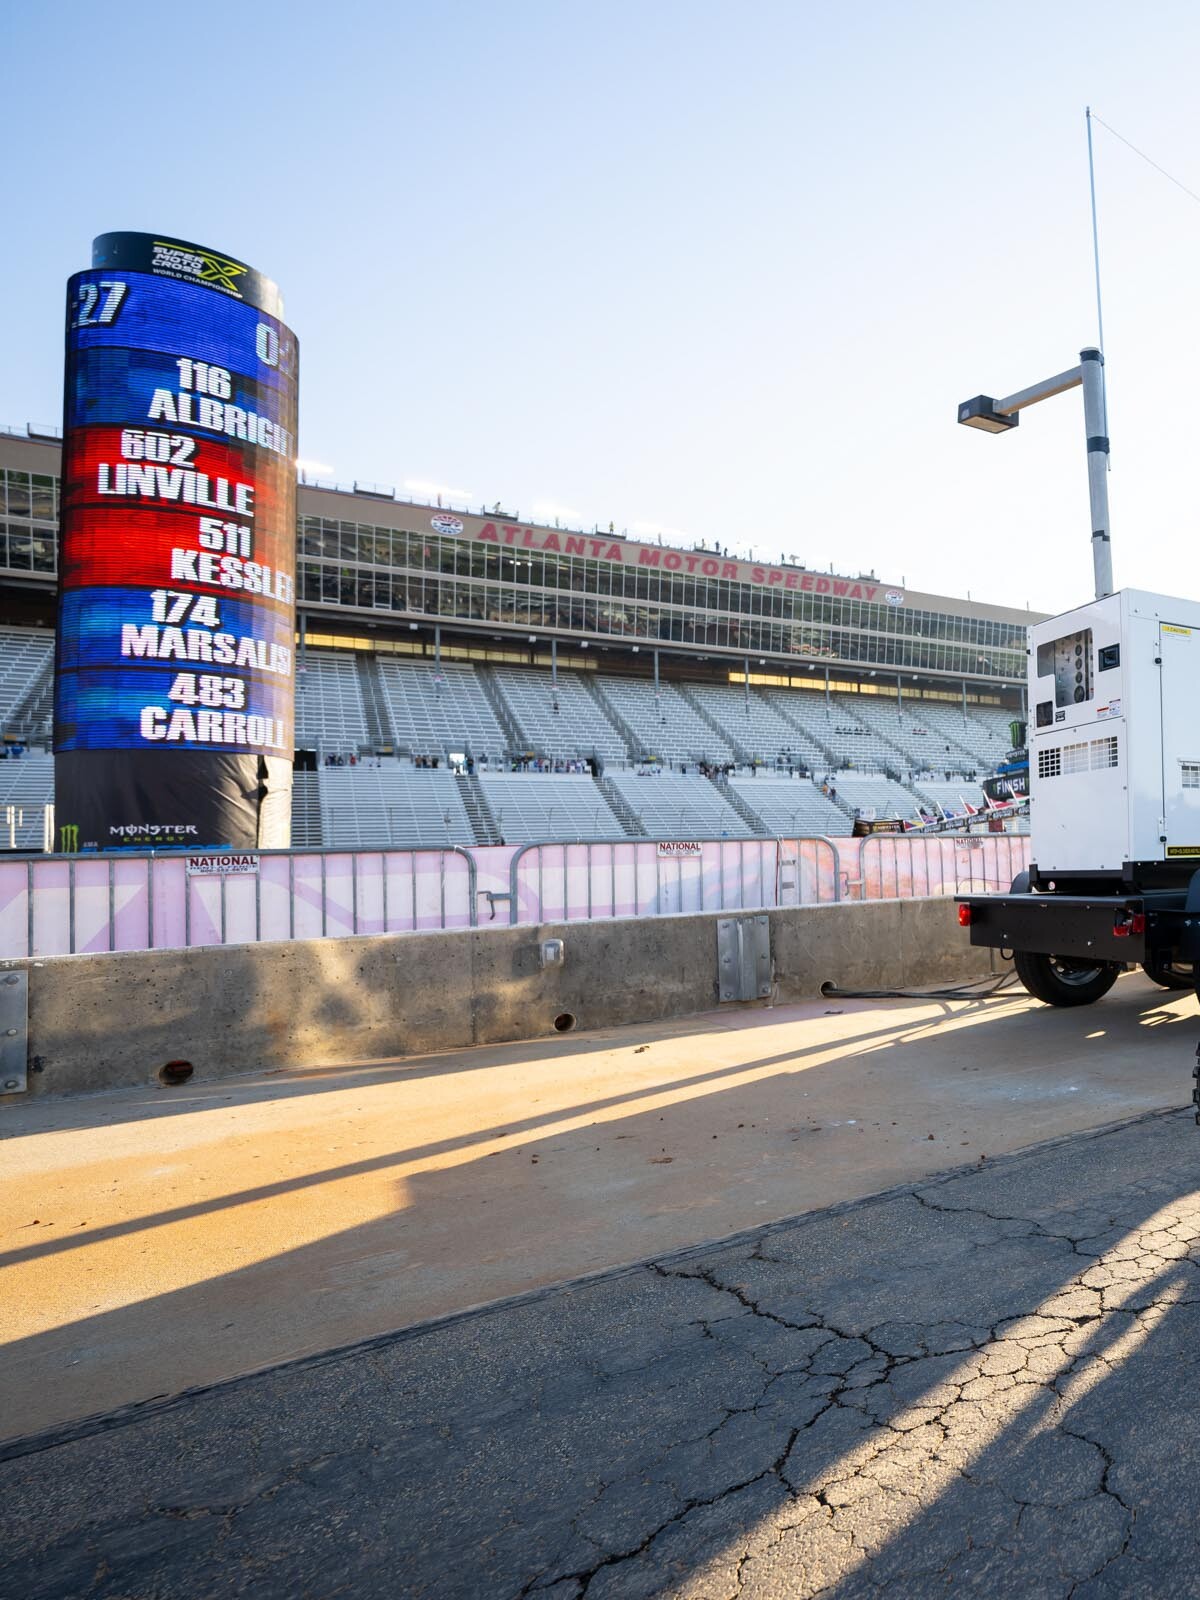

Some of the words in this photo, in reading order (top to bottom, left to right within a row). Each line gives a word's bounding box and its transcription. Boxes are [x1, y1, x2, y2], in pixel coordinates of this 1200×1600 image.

[151, 259, 202, 275] CROSS
[152, 246, 204, 264] SUPER
[156, 253, 202, 269] MOTO
[152, 268, 182, 279] WORLD
[183, 275, 243, 299] CHAMPIONSHIP
[176, 357, 231, 400] 116
[121, 428, 196, 468] 602
[98, 463, 254, 518] LINVILLE
[199, 516, 251, 559] 511
[478, 522, 623, 562] ATLANTA
[638, 548, 738, 580] MOTOR
[751, 567, 879, 601] SPEEDWAY
[150, 588, 221, 628] 174
[168, 672, 246, 710] 483
[109, 823, 198, 837] MONSTER
[659, 842, 702, 851] NATIONAL
[189, 856, 257, 867] NATIONAL
